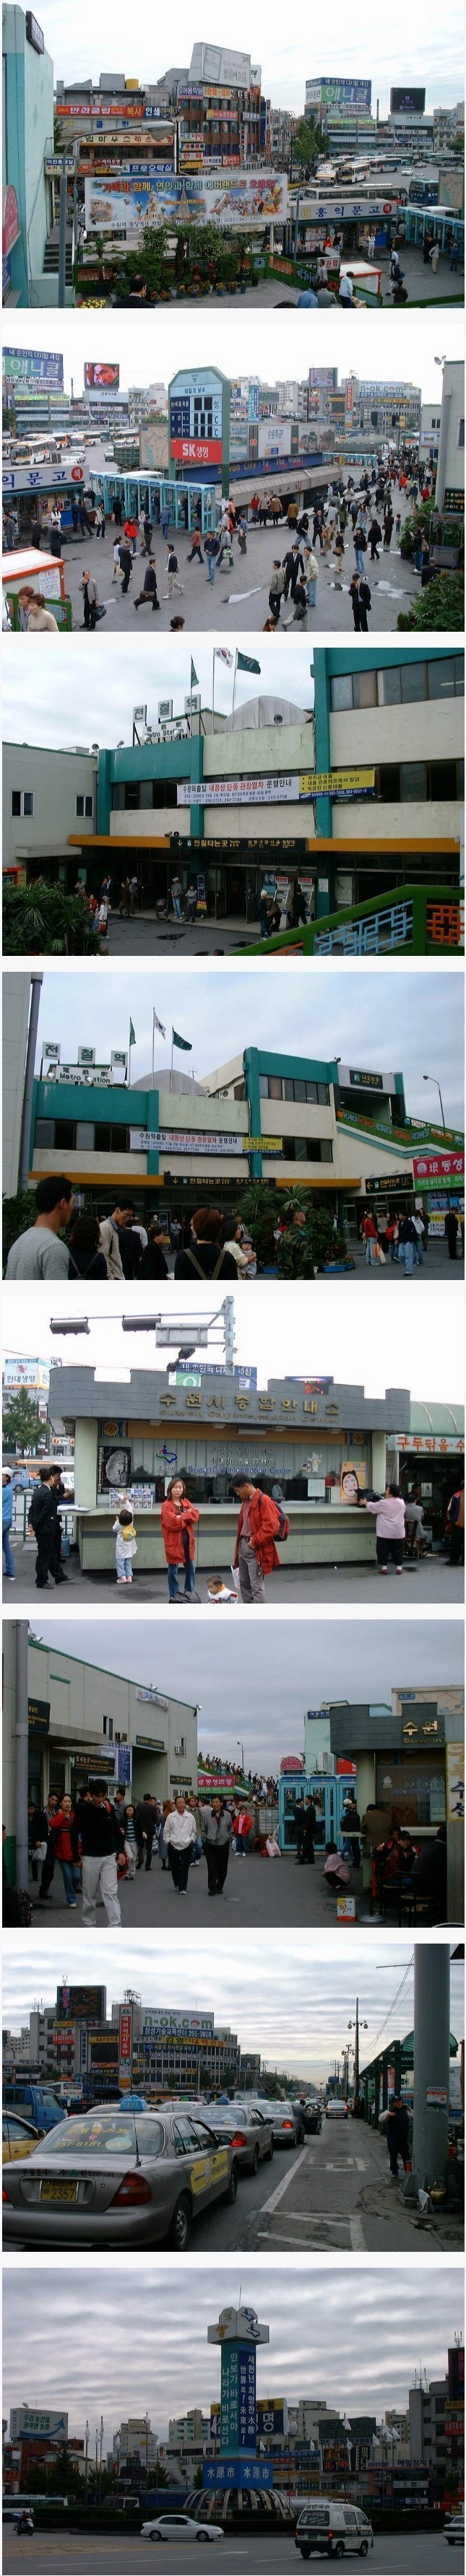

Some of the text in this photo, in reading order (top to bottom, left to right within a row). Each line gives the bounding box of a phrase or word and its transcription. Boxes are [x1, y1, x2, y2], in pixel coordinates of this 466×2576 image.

[325, 87, 368, 102] 애니콜
[127, 106, 142, 116] 복사
[145, 107, 160, 116] 인쇄
[156, 181, 181, 191] 연인과
[186, 180, 202, 190] 함께
[205, 180, 246, 189] 에버랜드로
[315, 205, 380, 217] 홍익문고
[10, 360, 59, 376] 애니콜
[227, 783, 238, 791] 단풍
[240, 781, 264, 790] 관광열차
[182, 1364, 251, 1377] 내 손안의 세상
[159, 1409, 202, 1417] Suwon
[207, 1411, 230, 1421] City
[233, 1413, 297, 1422] Information
[402, 1720, 439, 1736] 수원
[145, 2027, 187, 2037] 삼성기술교육센터
[51, 2188, 75, 2199] 2357
[221, 2404, 230, 2445] 바로선다
[248, 2417, 255, 2434] 水原
[207, 2466, 235, 2479] 水原市
[243, 2467, 269, 2479] 水原市
